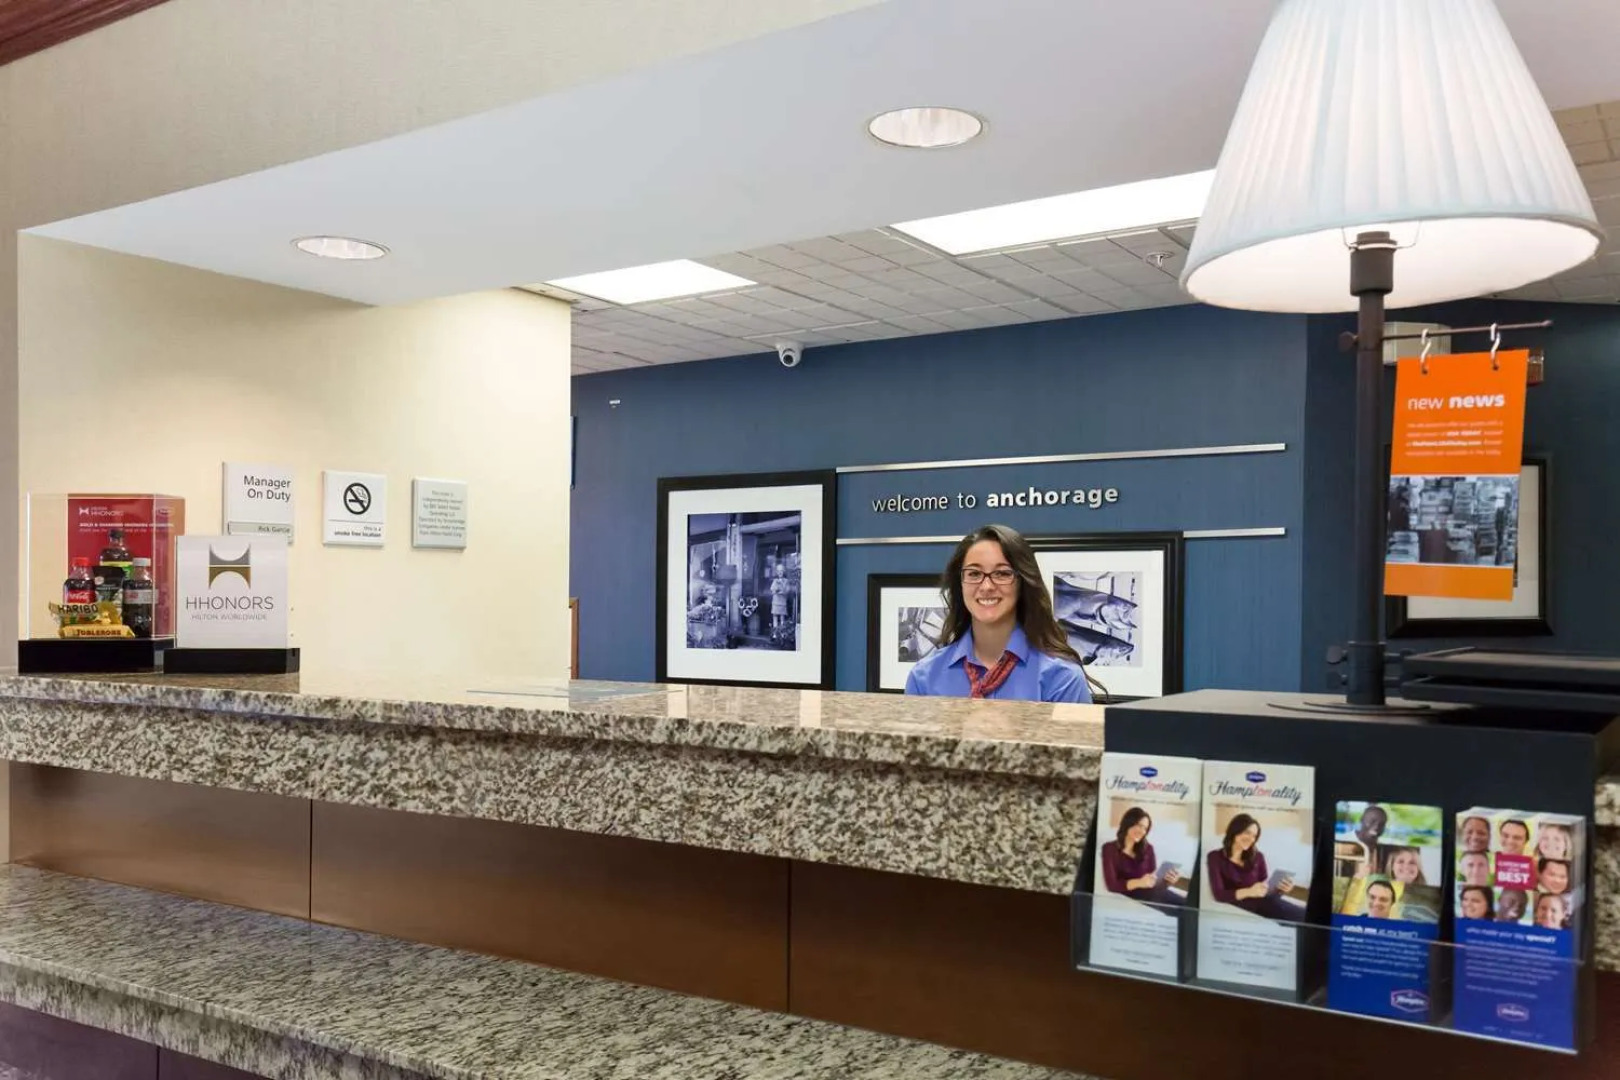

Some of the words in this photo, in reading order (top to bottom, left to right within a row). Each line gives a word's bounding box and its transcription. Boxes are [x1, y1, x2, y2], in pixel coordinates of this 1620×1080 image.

[1407, 397, 1443, 410] new
[1449, 394, 1505, 409] news
[243, 475, 291, 490] Manager
[247, 488, 263, 499] On
[266, 489, 291, 503] Duty
[872, 494, 949, 512] welcome
[957, 493, 976, 509] to
[986, 487, 1119, 508] anchorage
[57, 604, 98, 614] HARIBO
[185, 596, 274, 610] HHONORS
[1105, 775, 1190, 800] Hamptonality
[1209, 780, 1302, 806] Hamptonality
[1498, 871, 1530, 884] BEST
